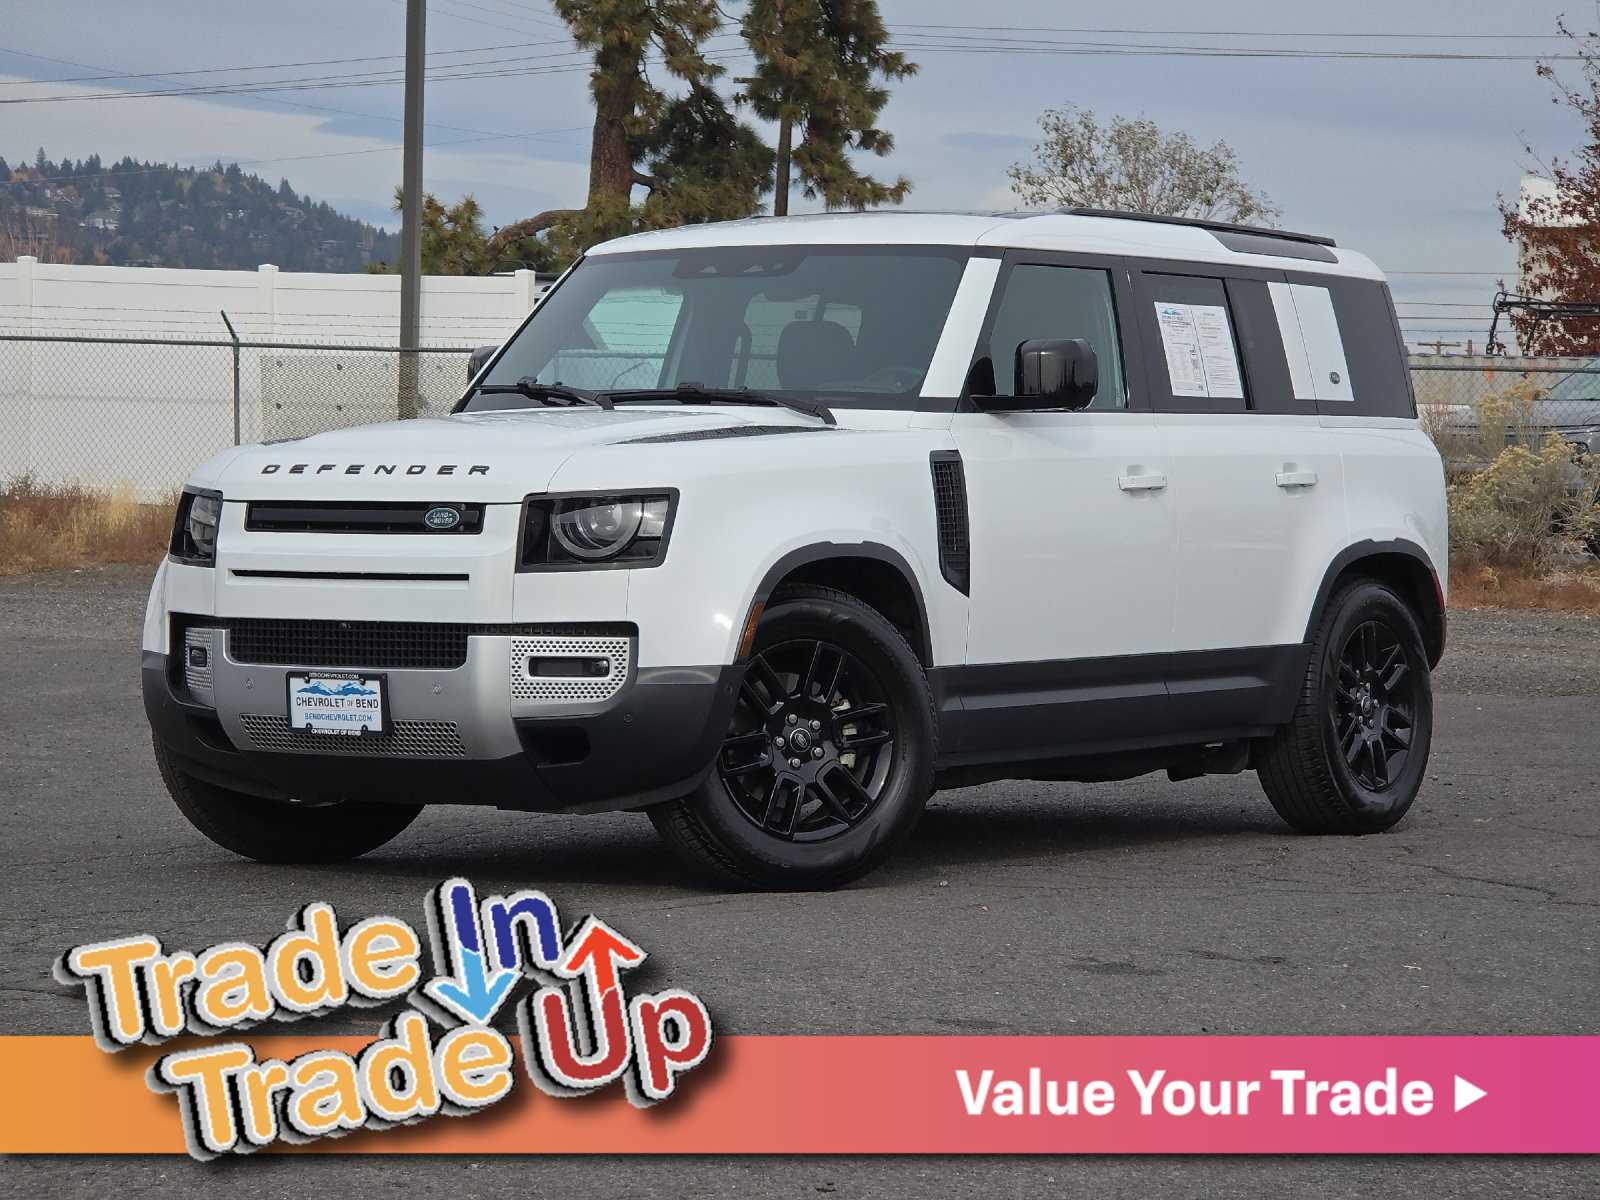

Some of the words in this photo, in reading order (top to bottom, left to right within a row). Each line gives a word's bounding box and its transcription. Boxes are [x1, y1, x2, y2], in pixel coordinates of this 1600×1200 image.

[261, 464, 490, 475] DEFENDER
[296, 697, 345, 708] CHEVROLET
[356, 698, 379, 708] BEND
[304, 712, 373, 722] BENDCHEVROLET.COM
